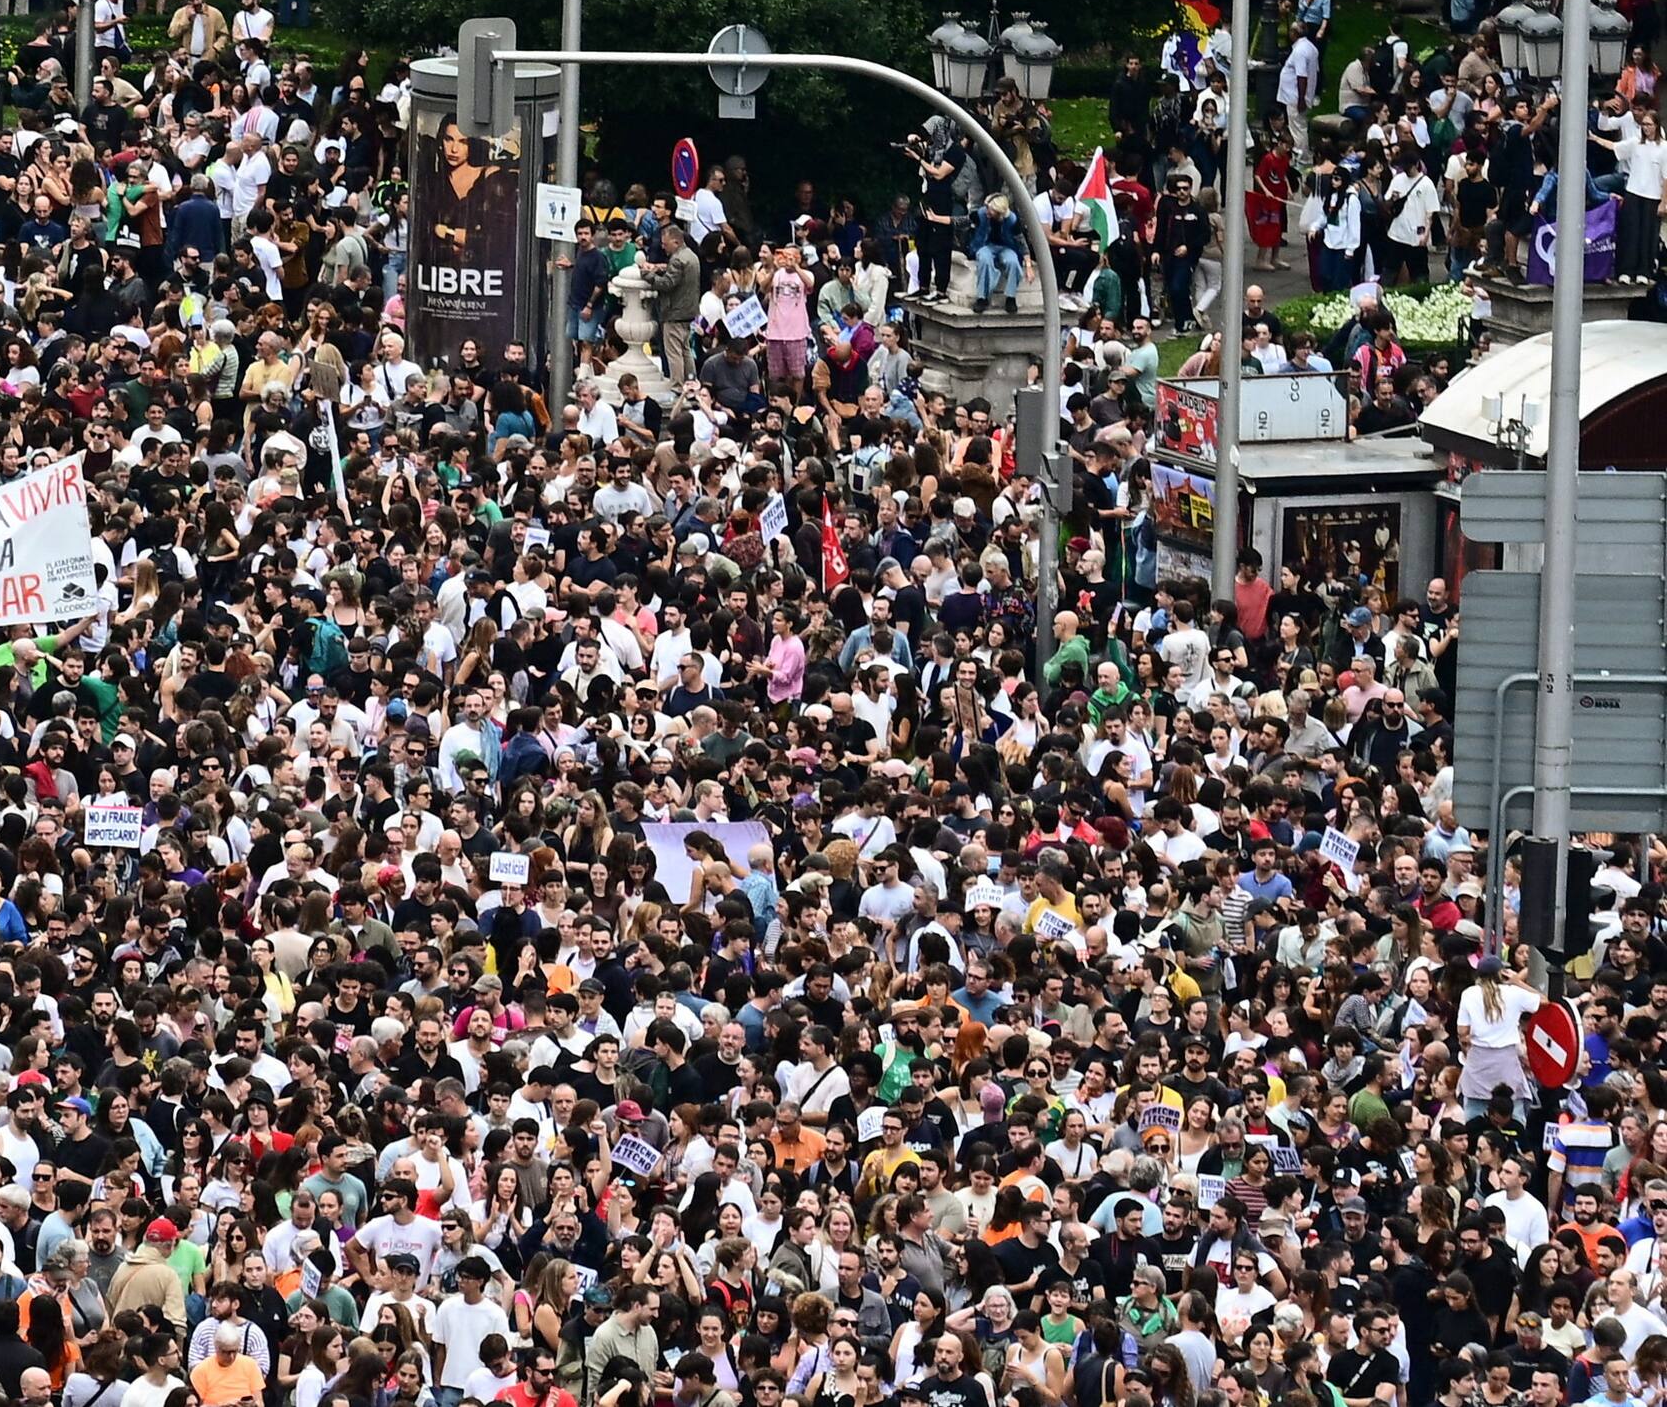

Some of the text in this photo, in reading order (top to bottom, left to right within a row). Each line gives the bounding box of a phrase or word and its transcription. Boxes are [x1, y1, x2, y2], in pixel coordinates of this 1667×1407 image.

[418, 264, 504, 297] LIBRE
[1177, 391, 1208, 414] MADRID
[1, 463, 83, 522] VIVIR
[89, 811, 99, 824] NO
[109, 811, 140, 825] FRAUDE
[1328, 831, 1357, 852] DERECHO
[615, 1145, 622, 1154] A
[622, 1147, 652, 1171] TECHO
[620, 1137, 657, 1162] DERECHO
